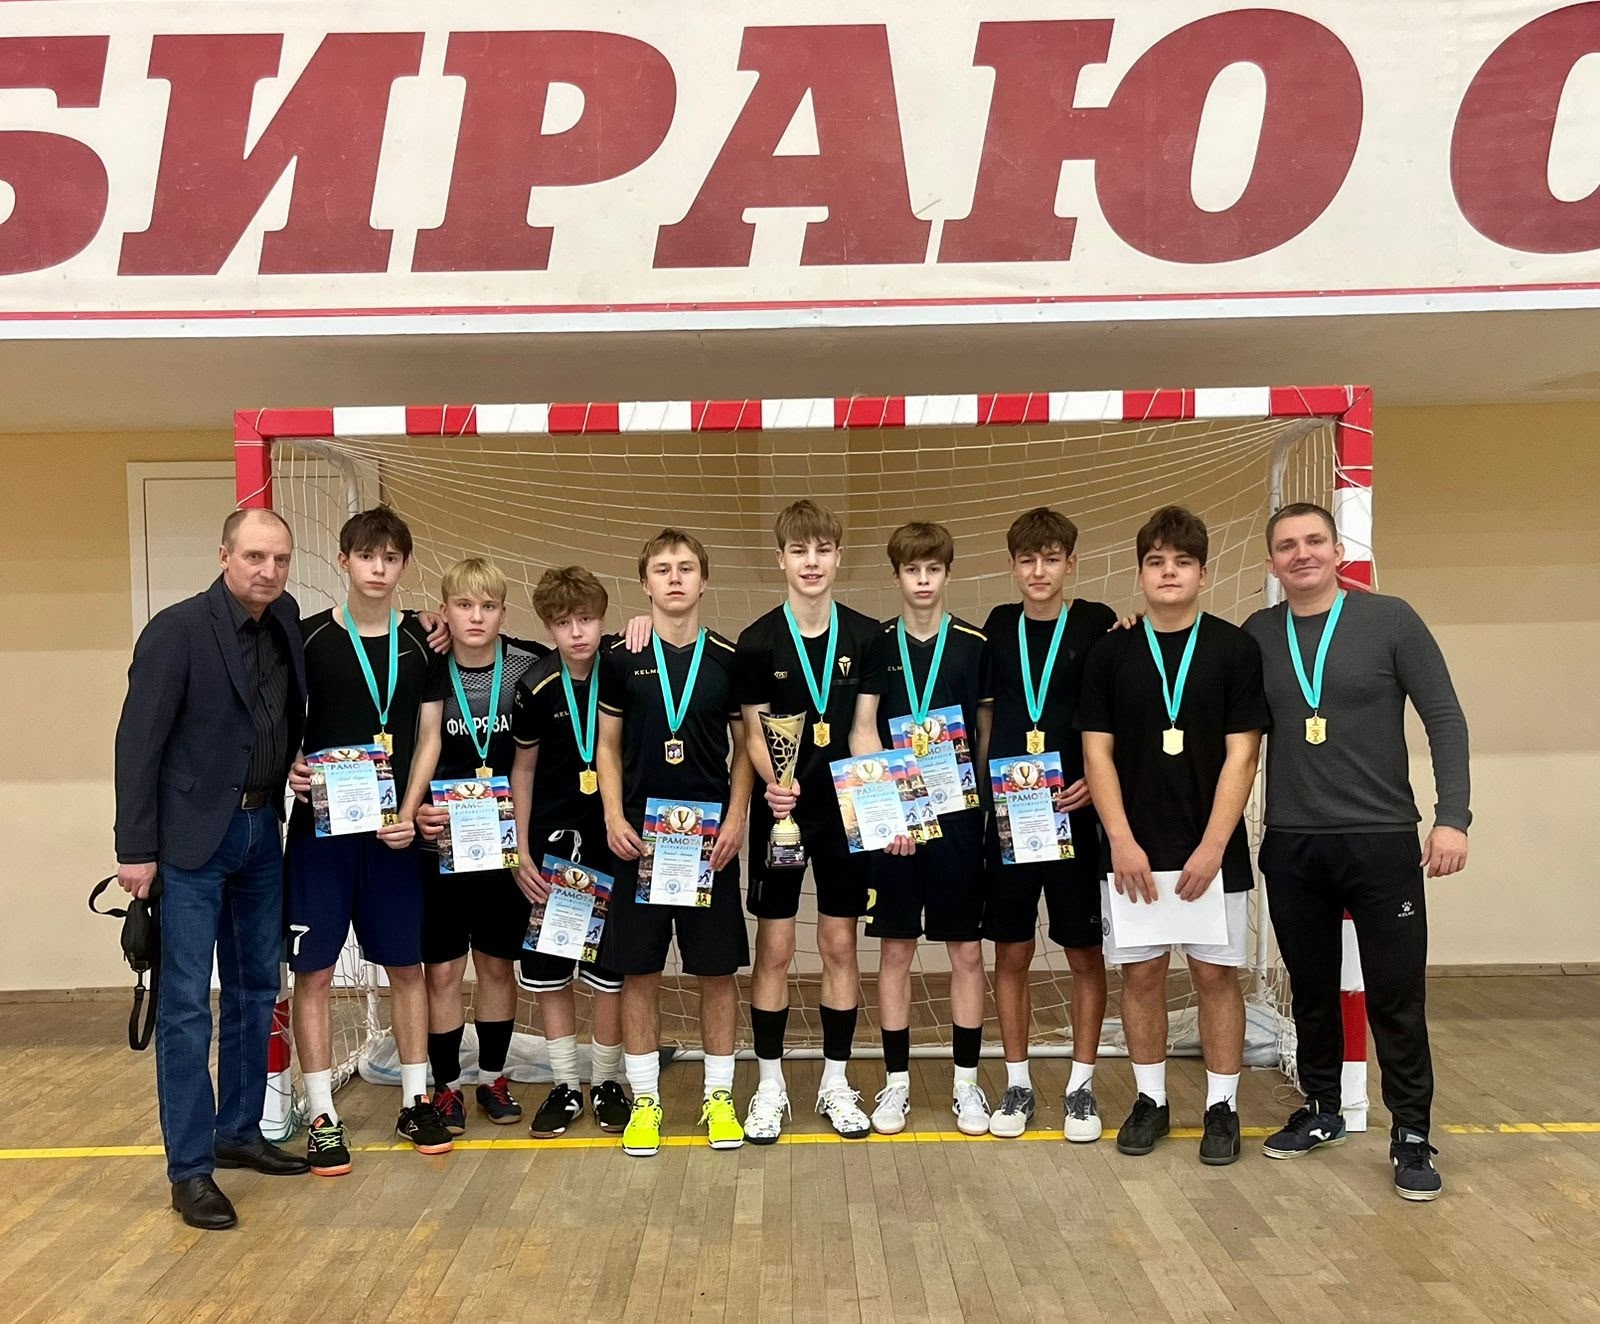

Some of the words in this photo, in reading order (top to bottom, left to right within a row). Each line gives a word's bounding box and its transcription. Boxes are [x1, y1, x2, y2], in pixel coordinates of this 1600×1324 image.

[634, 668, 658, 676] KELM
[446, 717, 470, 736] ФК
[289, 924, 311, 956] 7
